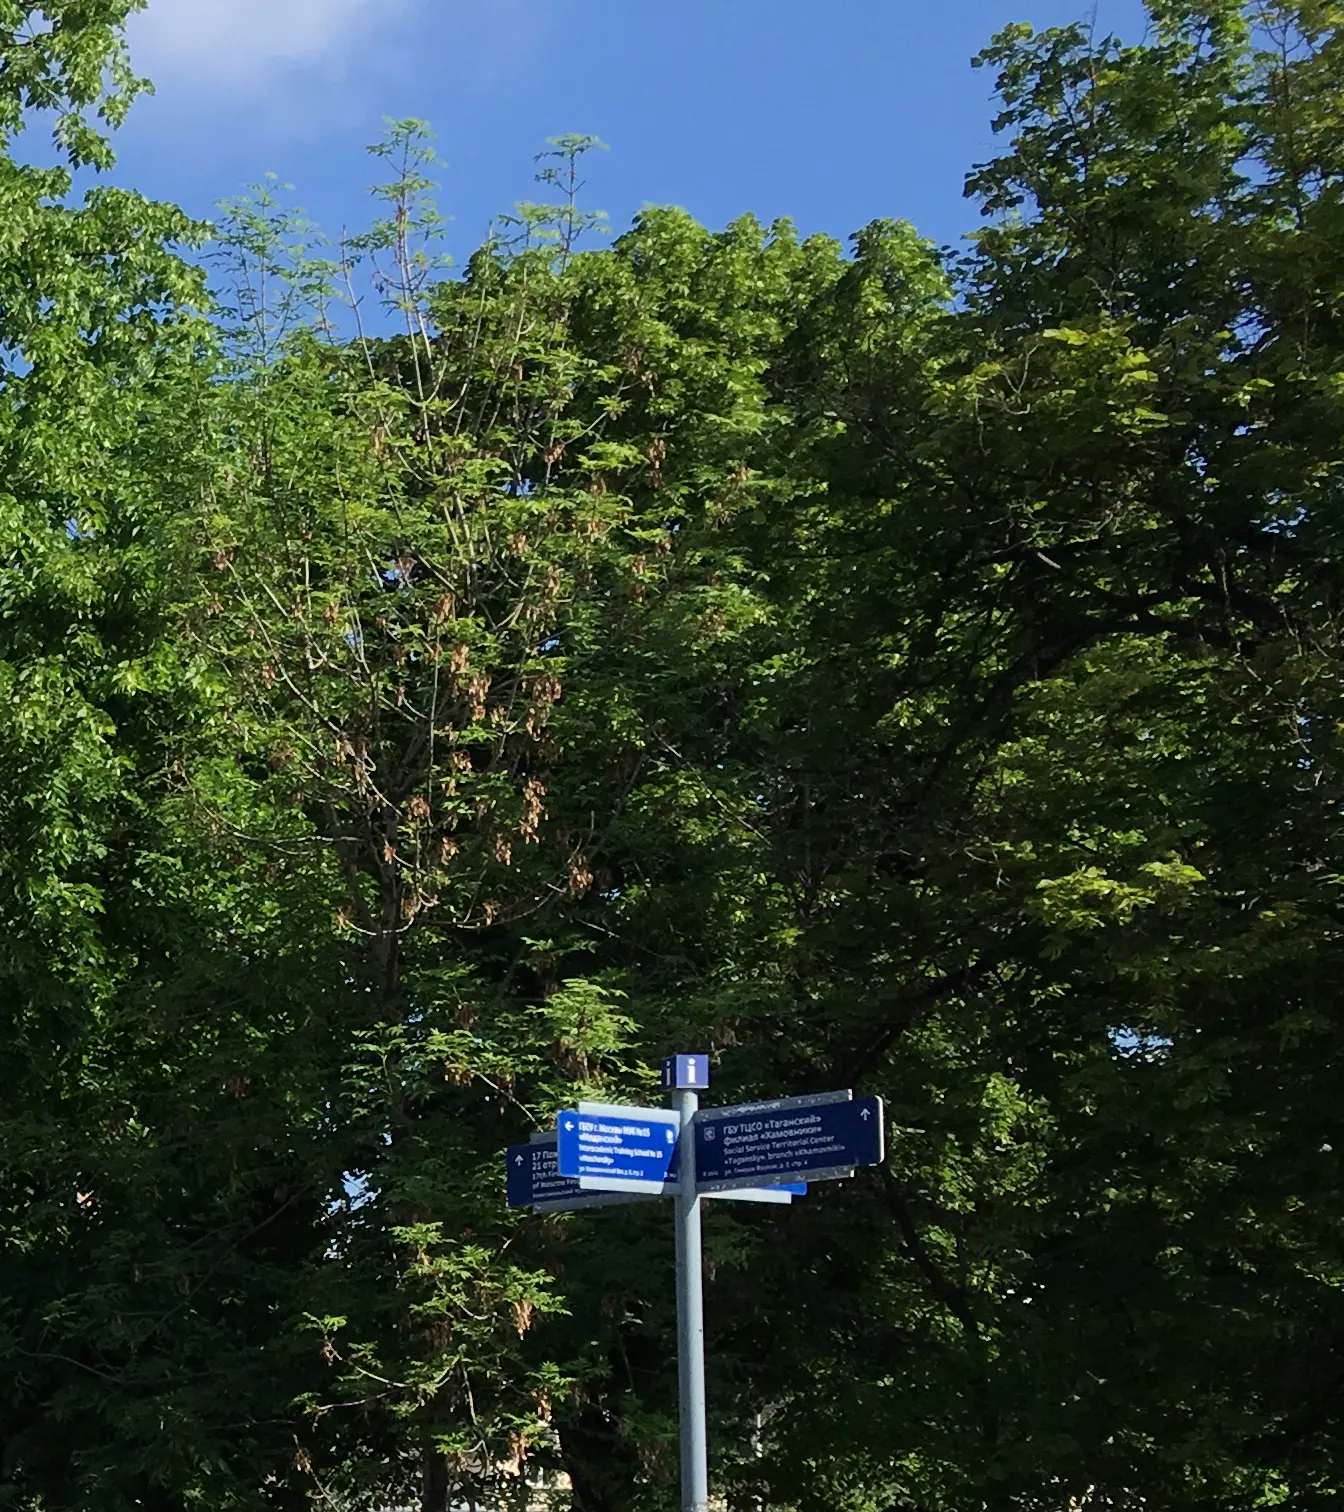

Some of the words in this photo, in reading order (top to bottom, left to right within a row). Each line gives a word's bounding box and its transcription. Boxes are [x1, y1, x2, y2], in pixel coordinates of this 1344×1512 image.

[723, 1125, 739, 1135] ГБУ
[739, 1121, 763, 1133] ТЦСО
[764, 1114, 822, 1129] «Таганский»
[532, 1152, 541, 1161] 17
